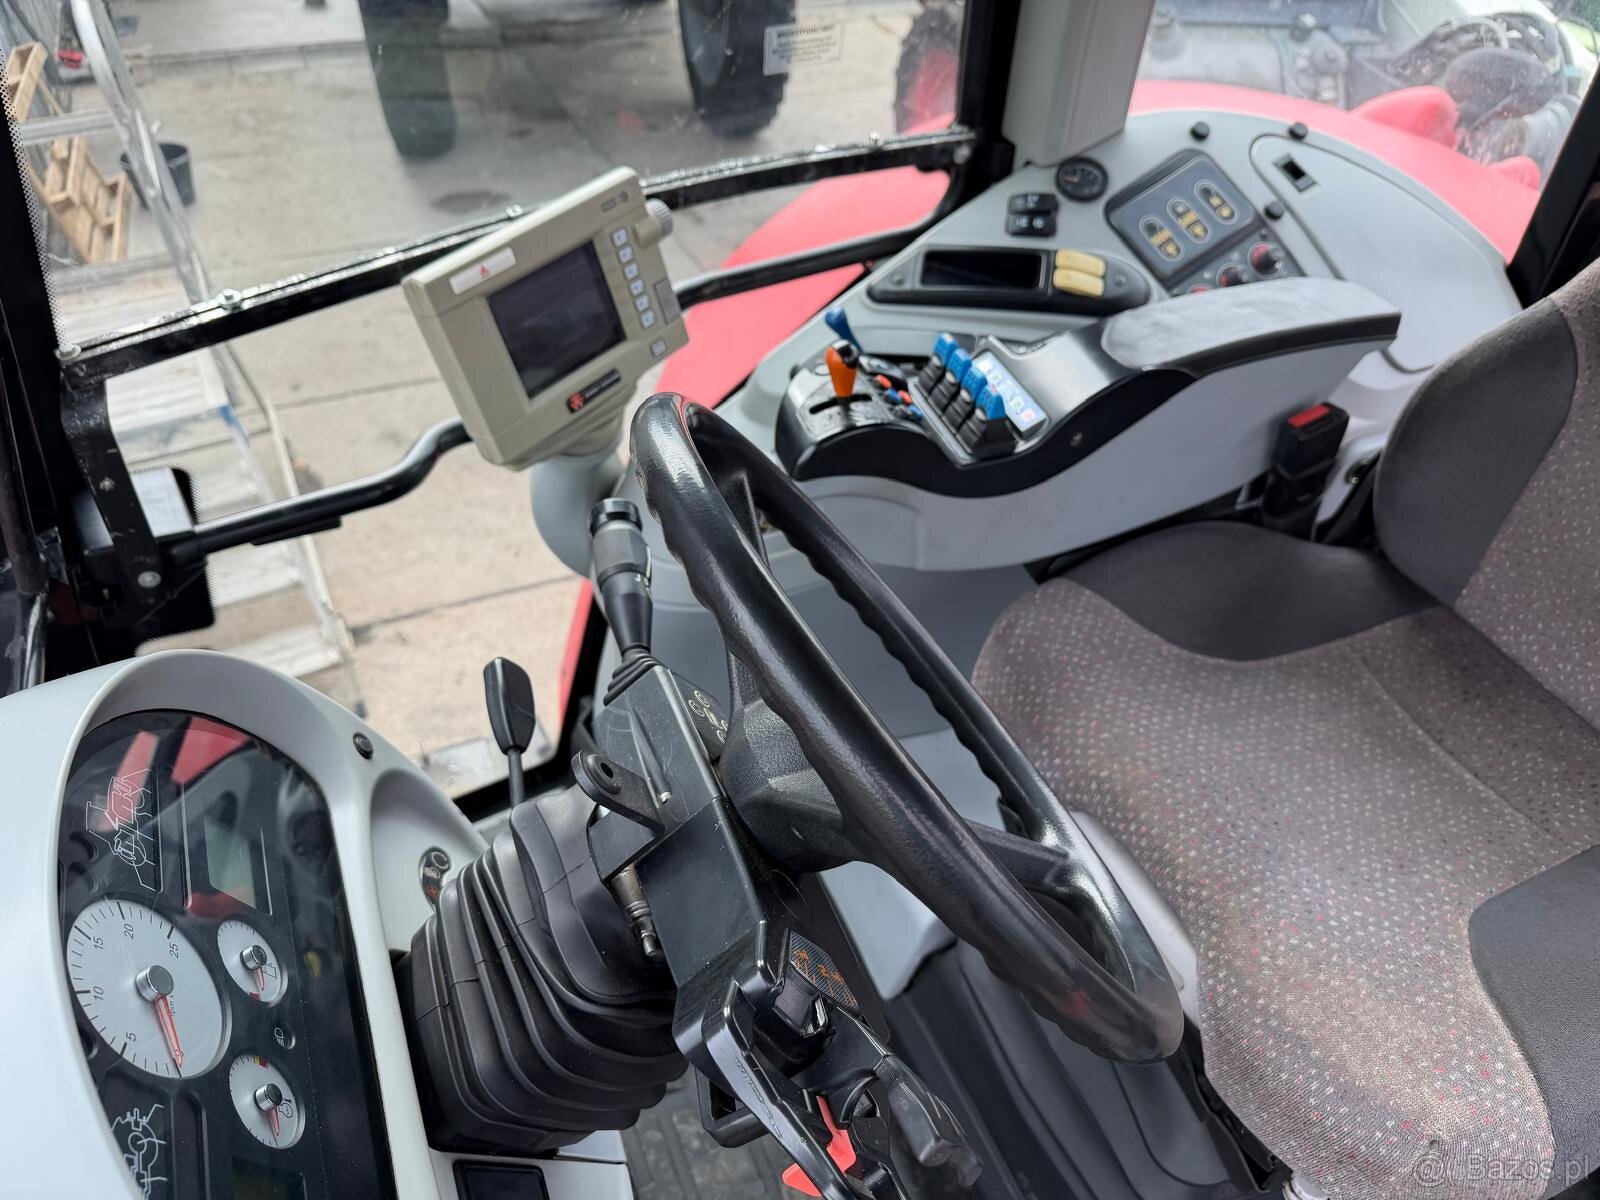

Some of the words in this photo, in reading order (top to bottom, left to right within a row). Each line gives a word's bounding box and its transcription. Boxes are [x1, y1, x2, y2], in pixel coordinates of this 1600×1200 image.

[124, 923, 134, 940] 20
[94, 937, 104, 950] 15
[169, 943, 179, 959] 25
[94, 986, 104, 1001] 10
[126, 1032, 137, 1042] 5
